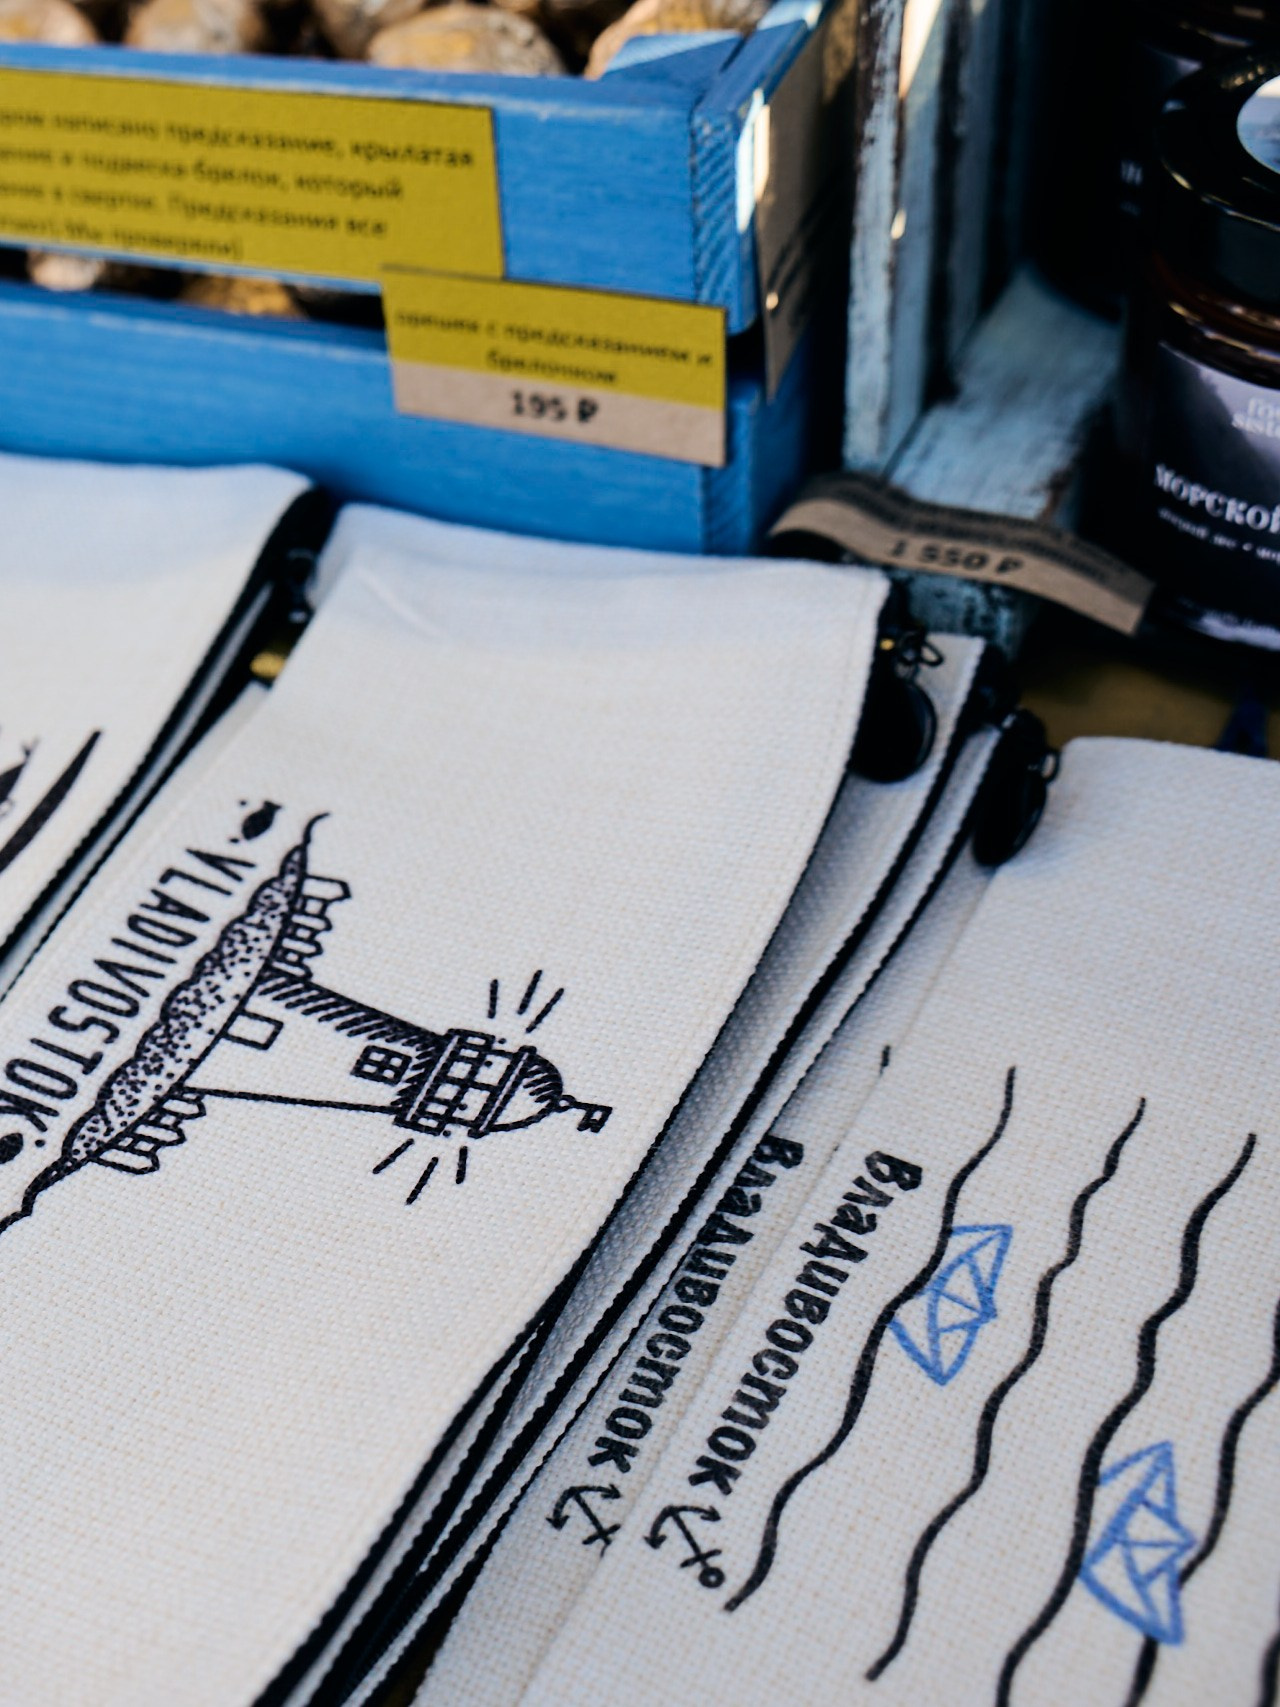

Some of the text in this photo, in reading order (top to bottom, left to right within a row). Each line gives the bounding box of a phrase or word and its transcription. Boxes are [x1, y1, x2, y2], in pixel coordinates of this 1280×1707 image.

[349, 140, 474, 170] крылатая
[294, 173, 404, 202] который
[511, 389, 568, 422] 195
[687, 1150, 924, 1496] Владивосток
